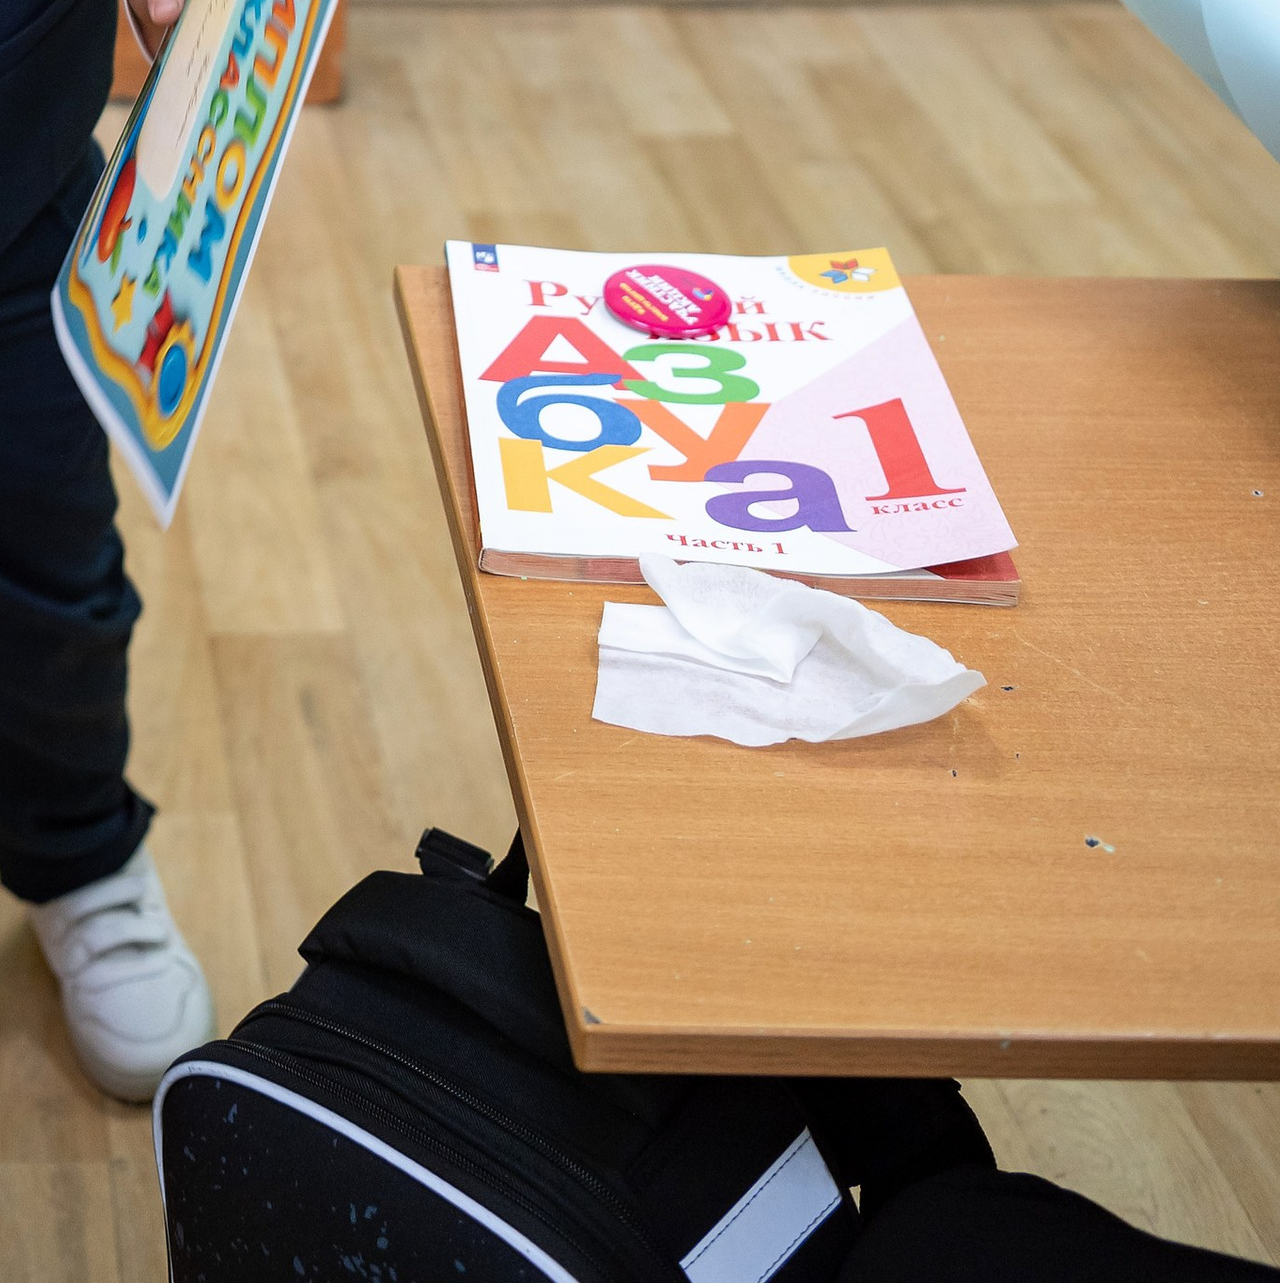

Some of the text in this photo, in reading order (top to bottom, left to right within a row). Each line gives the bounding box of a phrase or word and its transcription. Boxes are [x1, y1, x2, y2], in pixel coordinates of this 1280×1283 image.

[832, 397, 967, 501] 1
[870, 497, 965, 515] класс
[665, 534, 789, 555] Часть 1
